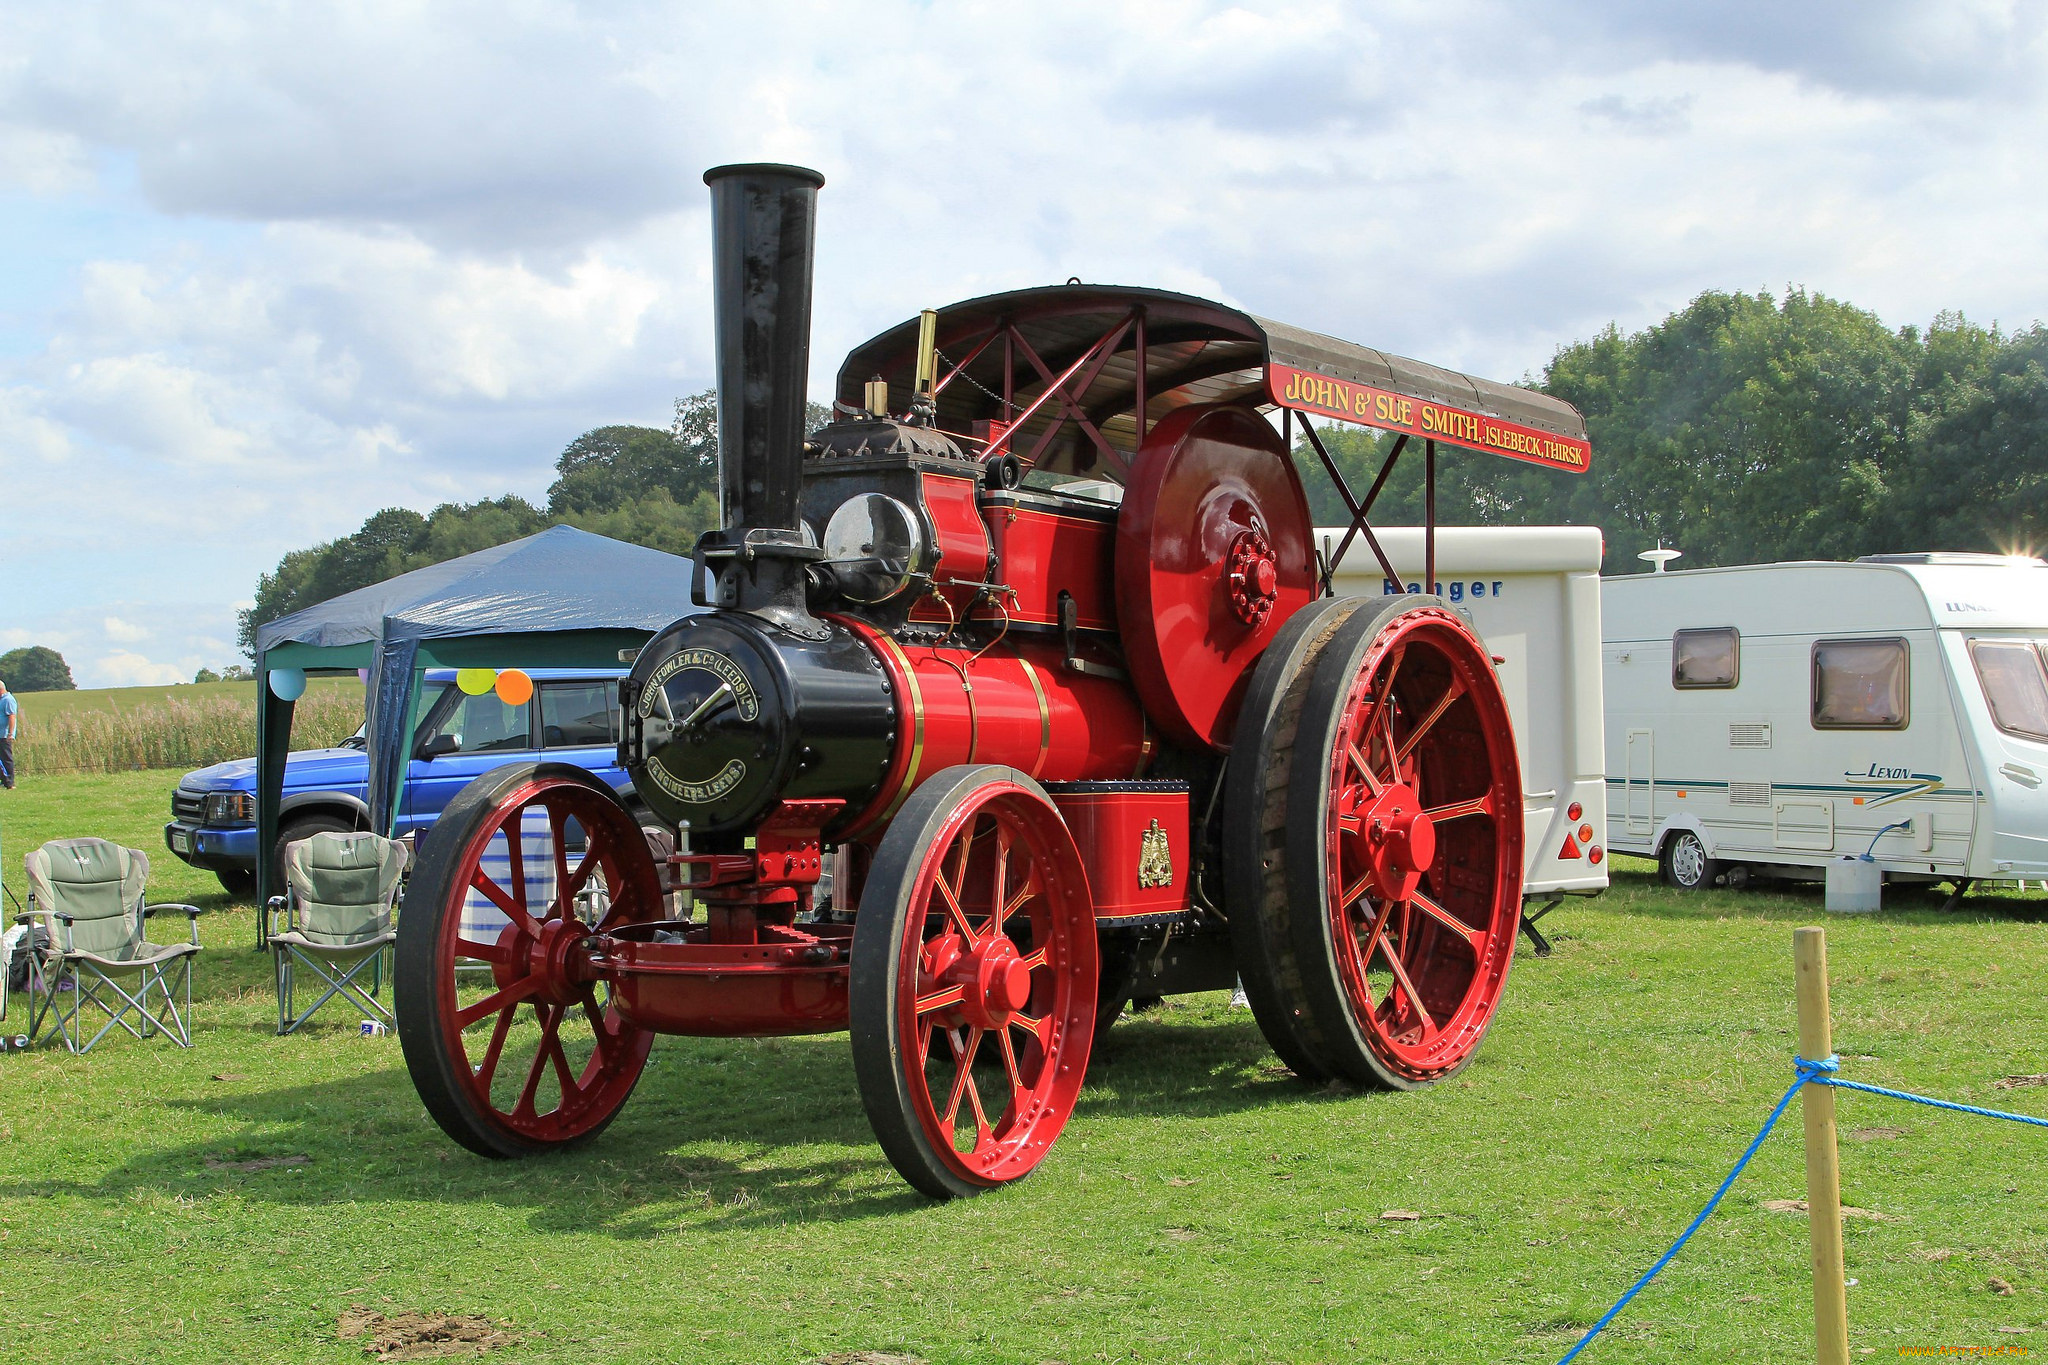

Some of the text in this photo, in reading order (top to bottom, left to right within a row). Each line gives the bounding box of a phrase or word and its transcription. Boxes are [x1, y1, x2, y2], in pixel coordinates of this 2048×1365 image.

[1284, 373, 1584, 466] JOHN & SUE SMITH, ISLEBECK, THIRSK
[642, 678, 659, 709] JOHN
[655, 653, 691, 682] FOWLER
[692, 652, 701, 664] &
[714, 659, 748, 695] (LEEDS)
[706, 767, 740, 797] LEEDS
[1868, 763, 1911, 779] LEXON
